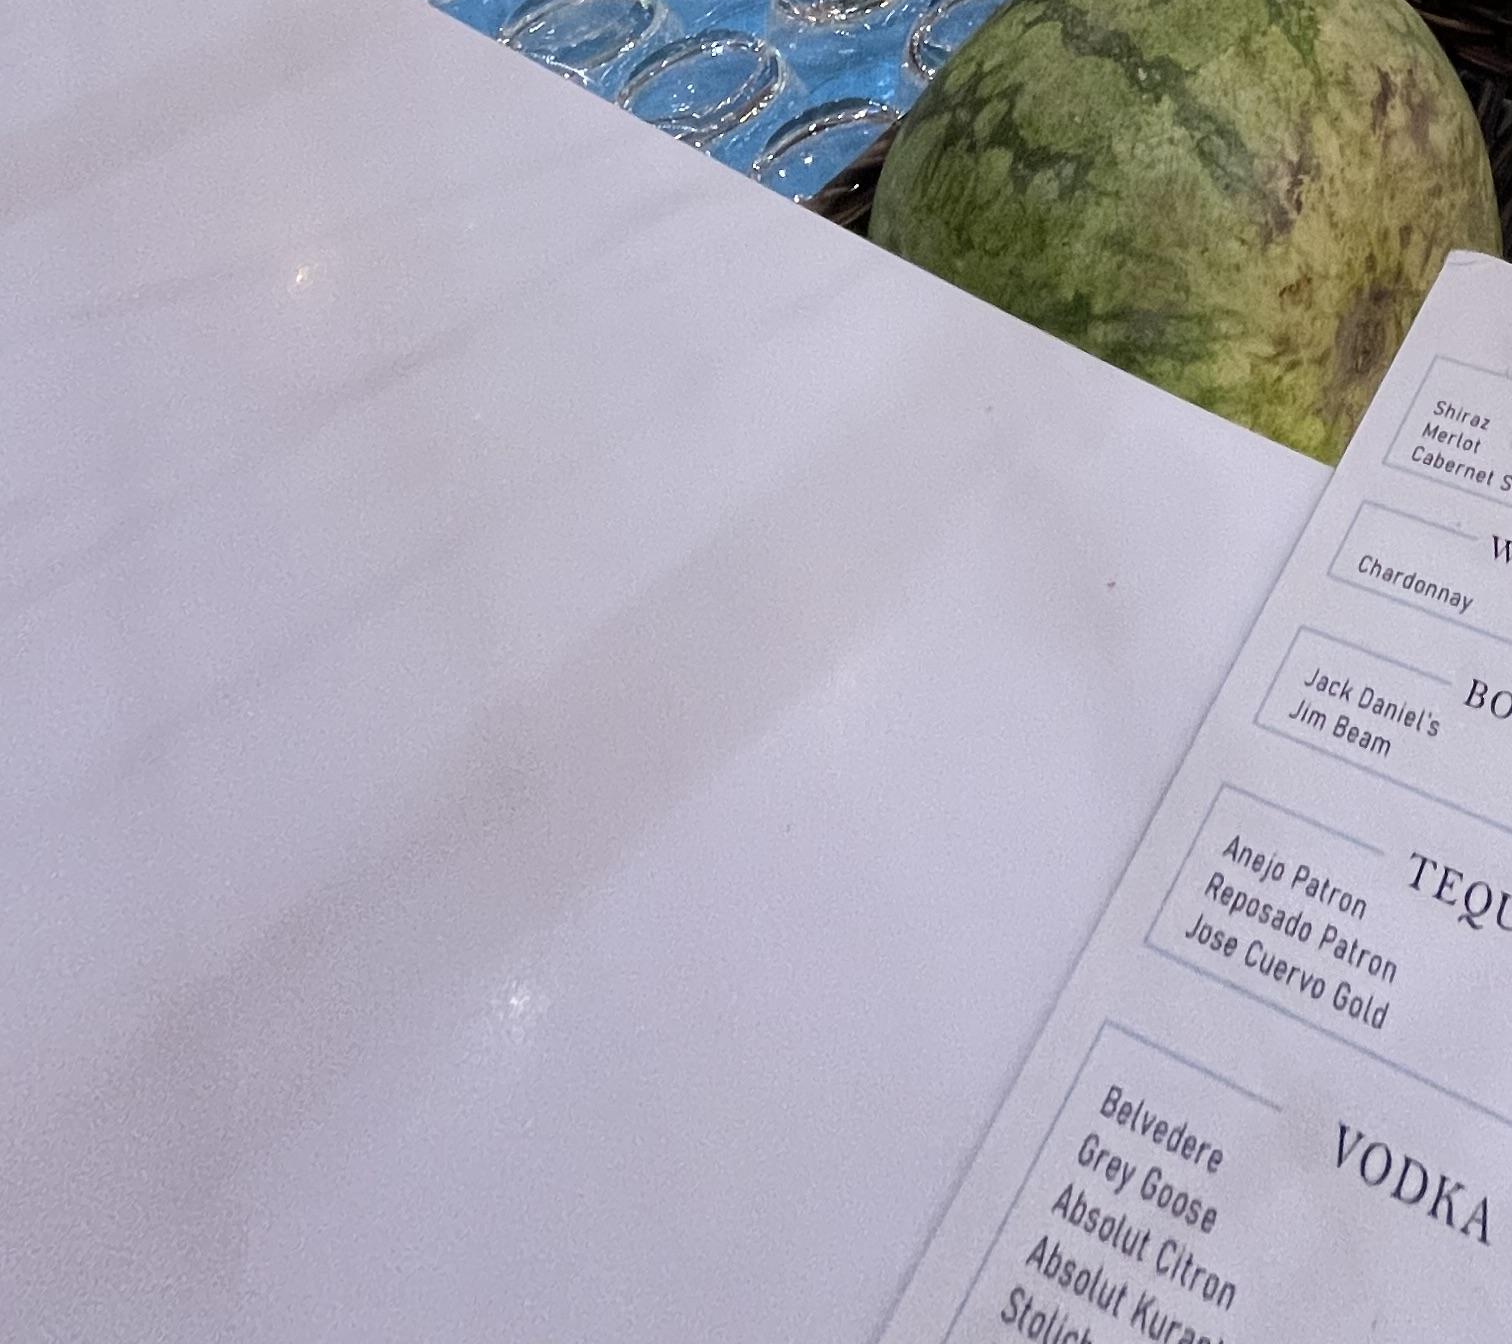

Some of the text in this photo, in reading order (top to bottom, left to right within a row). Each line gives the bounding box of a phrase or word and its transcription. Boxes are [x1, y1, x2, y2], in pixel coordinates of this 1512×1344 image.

[1421, 421, 1482, 455] Merlot
[1432, 400, 1491, 431] Shiraz
[1410, 445, 1495, 487] Cabernet
[1357, 554, 1474, 615] Chardonnay
[1287, 699, 1392, 758] Jim Beam
[1303, 667, 1441, 738] Jack Daniel's
[1221, 834, 1368, 921] Anejo Patron
[1203, 871, 1398, 985] Reposado Patron
[1184, 913, 1391, 1030] Jose Cuervo Gold
[1099, 1084, 1224, 1175] Belvedere
[1077, 1132, 1218, 1235] Grey Goose
[1335, 1120, 1491, 1247] VODKA
[1024, 1234, 1128, 1318] Absolut
[1050, 1182, 1237, 1311] Absolut Citron
